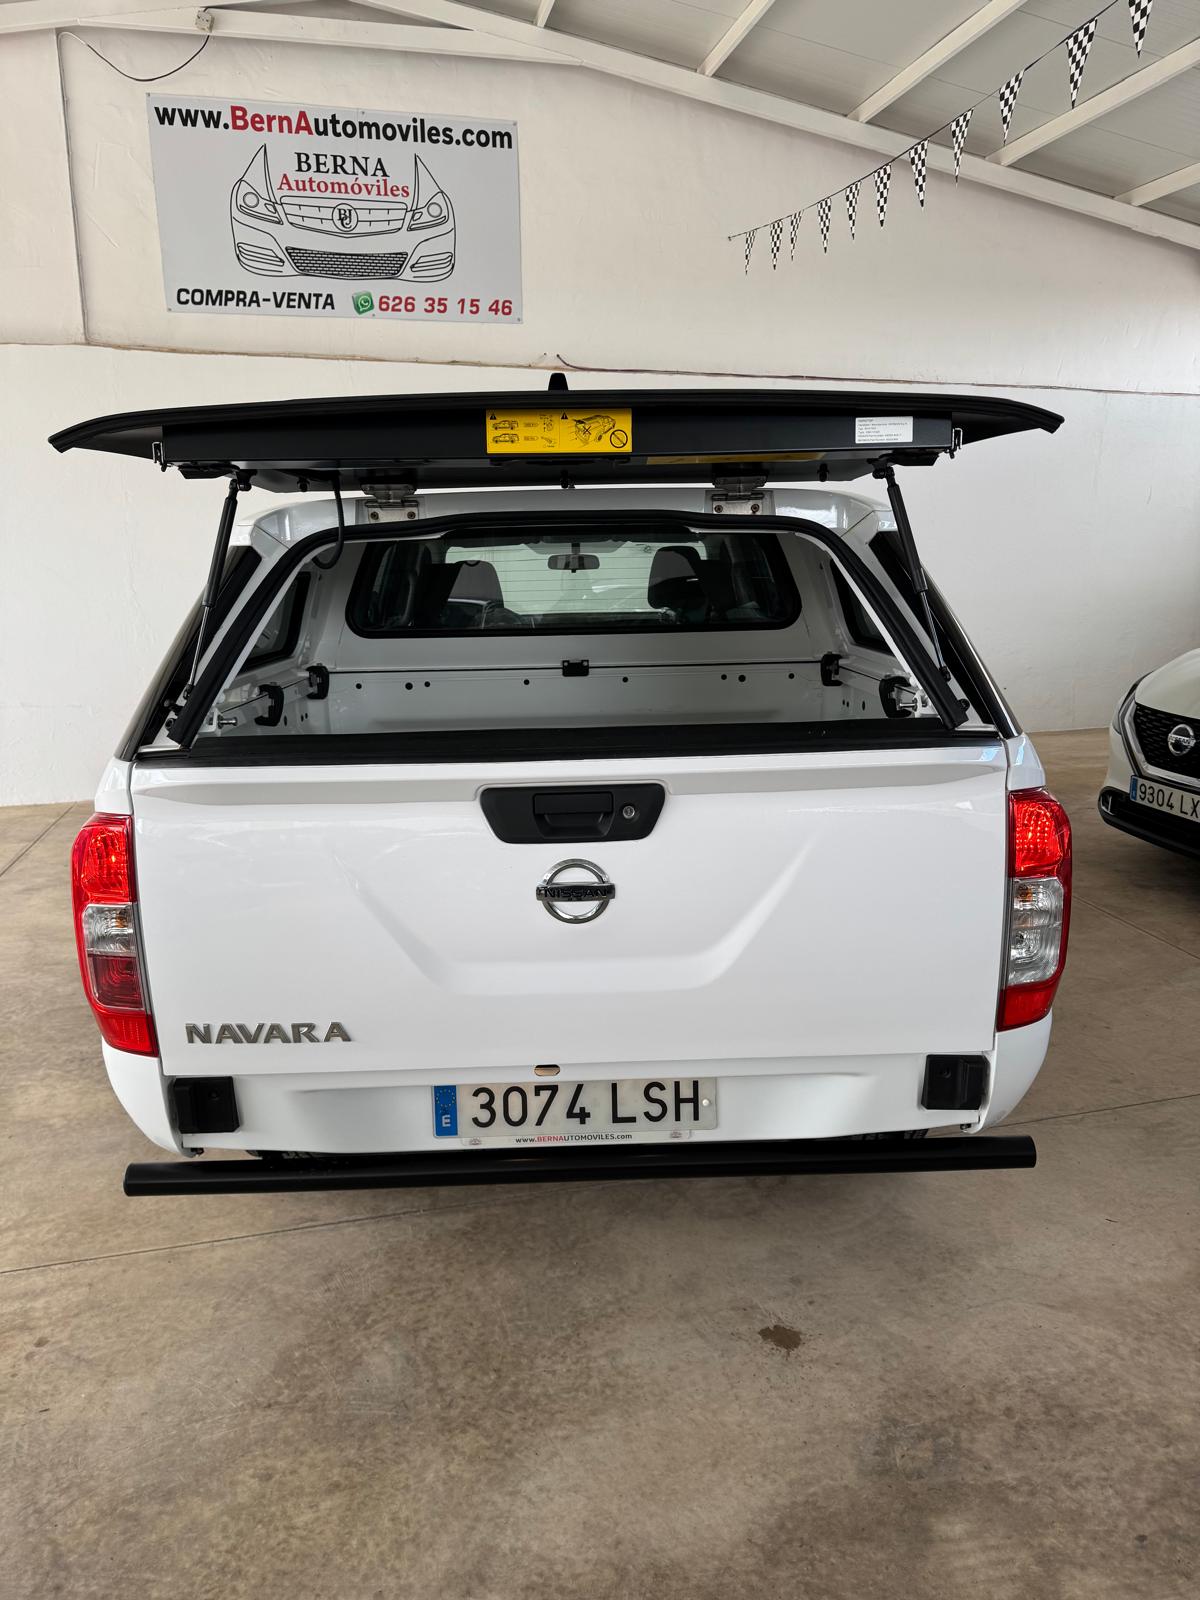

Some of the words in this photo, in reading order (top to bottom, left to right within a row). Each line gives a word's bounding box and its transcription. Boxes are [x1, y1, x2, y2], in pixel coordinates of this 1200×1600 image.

[154, 105, 513, 149] www.BernAutomoviles.com
[294, 151, 390, 178] BERNA
[276, 173, 410, 198] Automóviles
[176, 288, 335, 311] COMPRA-VENTA
[378, 295, 416, 313] 626
[424, 296, 448, 314] 35
[458, 298, 480, 315] 15
[488, 299, 513, 316] 46
[1139, 783, 1174, 810] 9304
[544, 887, 607, 898] NISSAN
[185, 1021, 352, 1044] NAVARA
[471, 1083, 591, 1128] 3074
[611, 1080, 700, 1123] LSH
[442, 1114, 451, 1127] E
